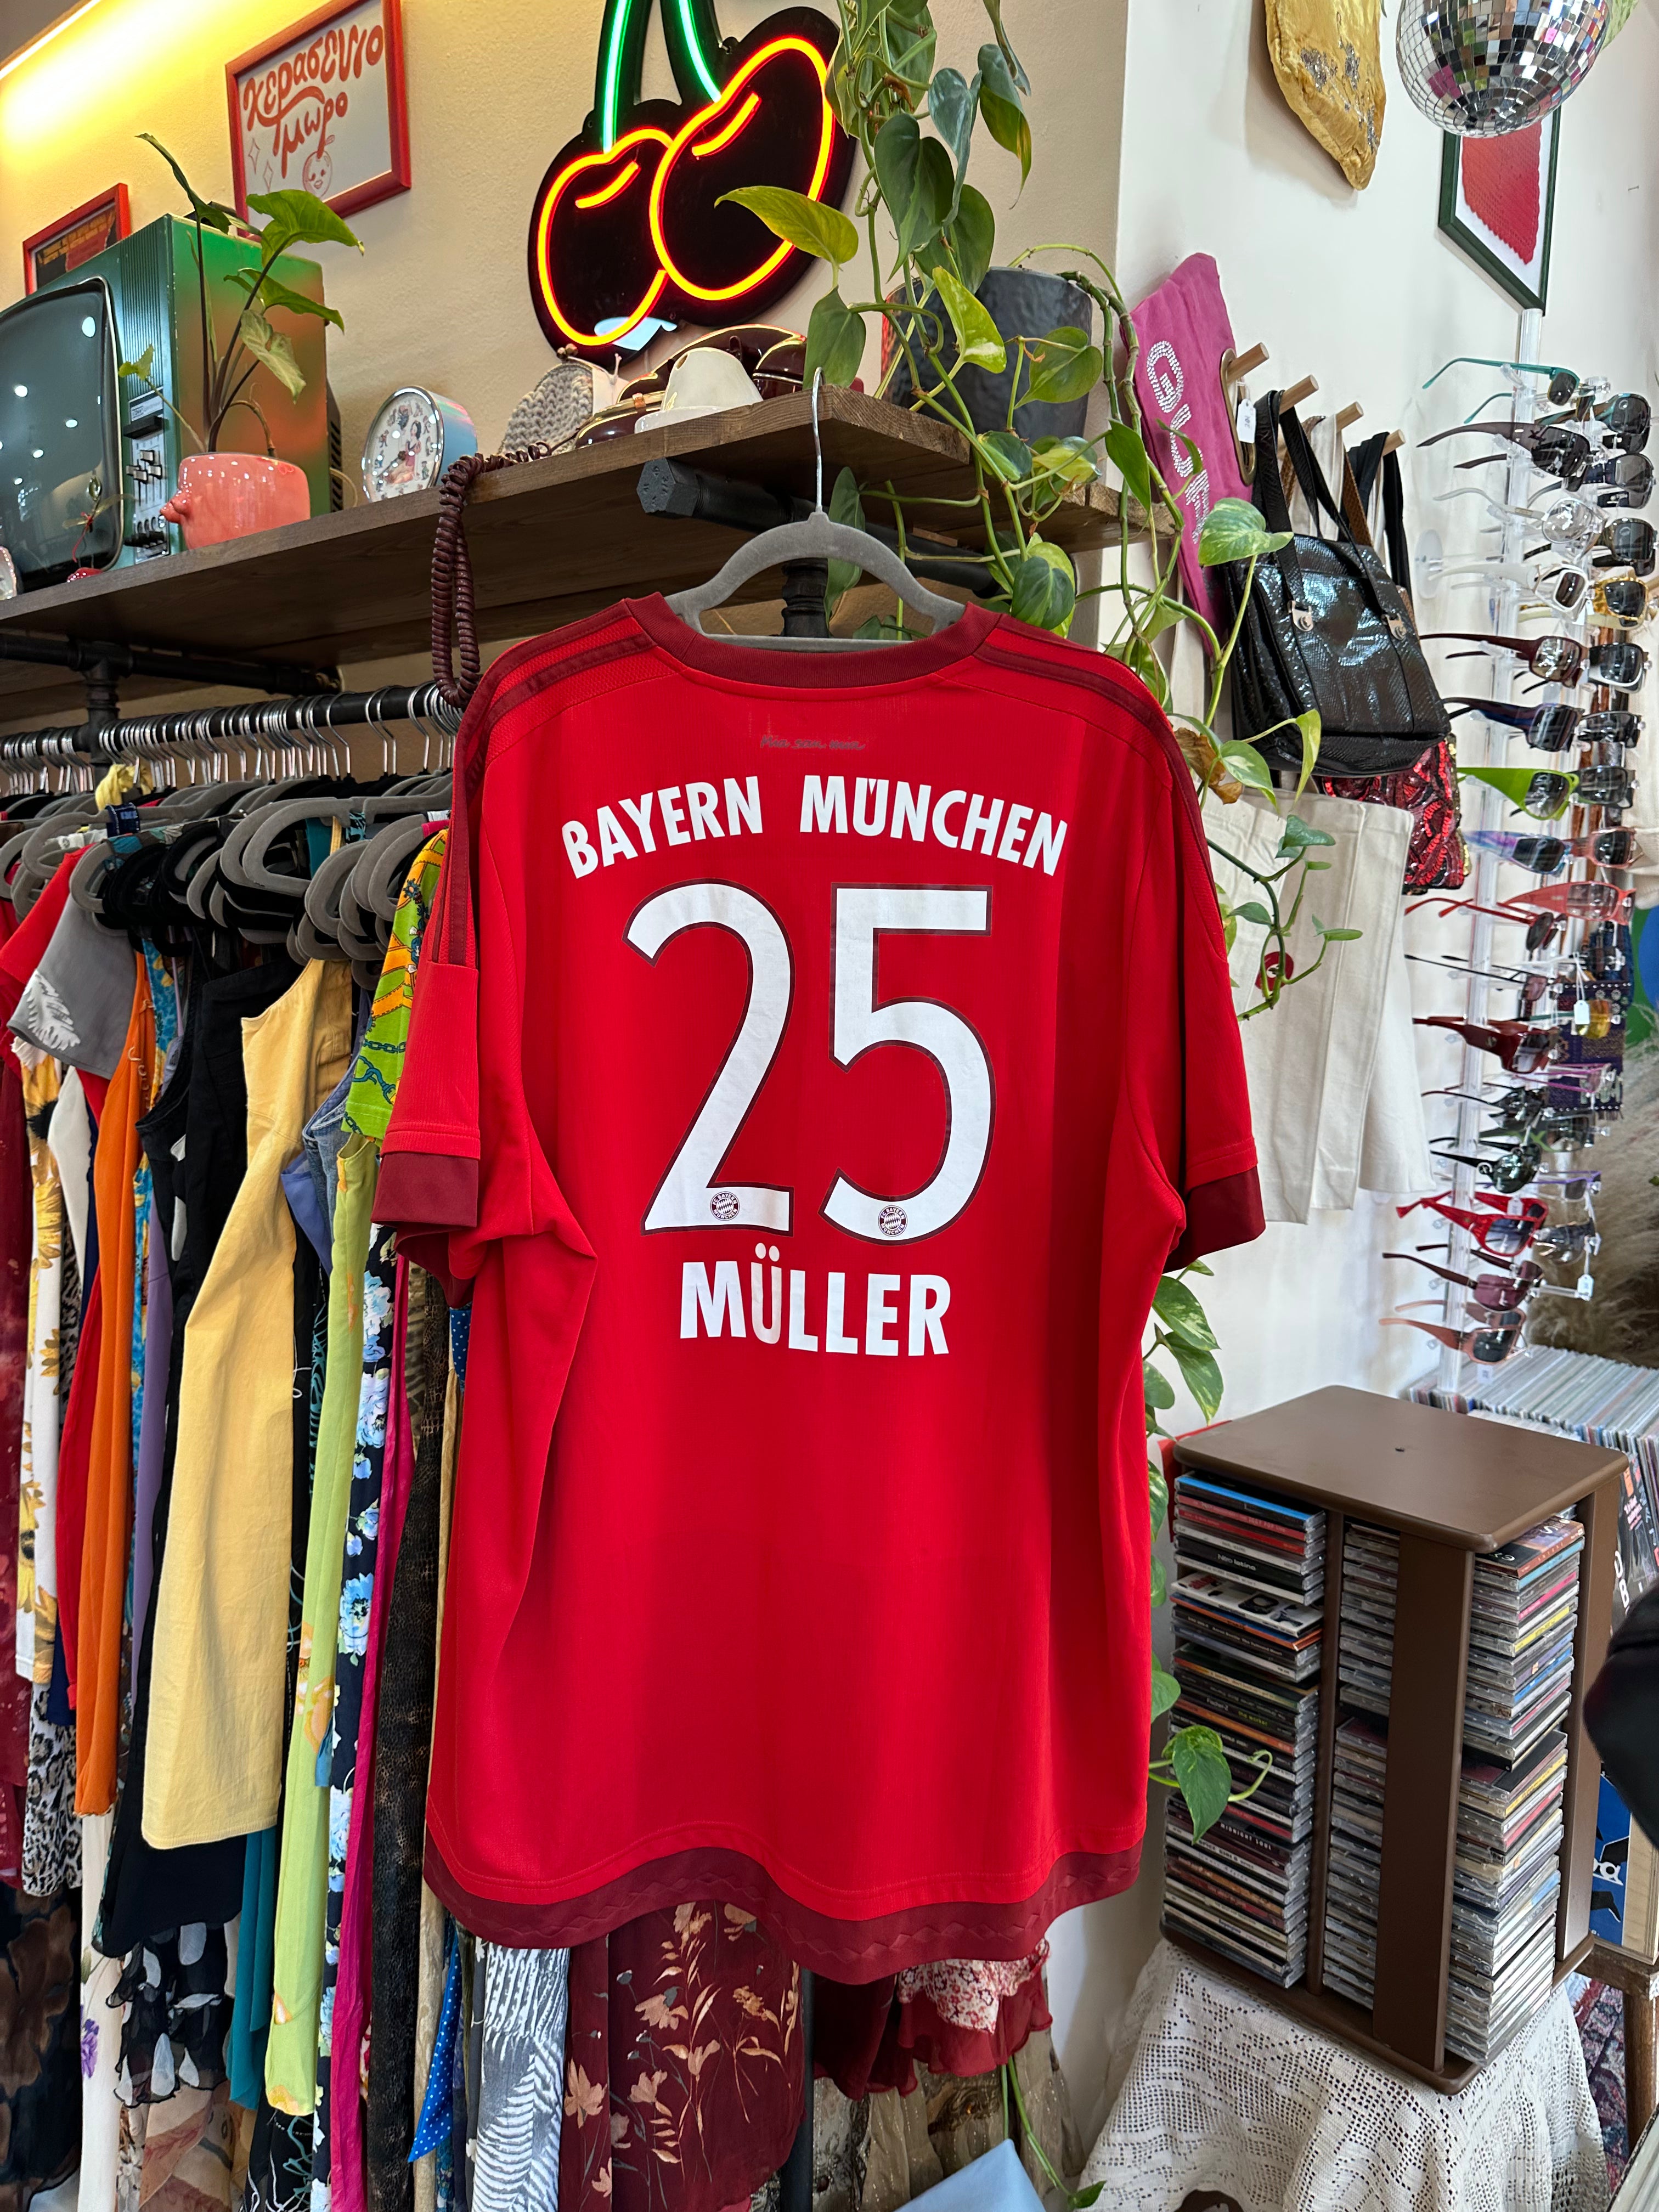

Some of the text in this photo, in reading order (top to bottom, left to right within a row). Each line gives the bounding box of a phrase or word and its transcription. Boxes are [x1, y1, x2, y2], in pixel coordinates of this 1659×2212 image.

[1147, 340, 1210, 544] GUR
[561, 775, 1068, 879] BAYERN MÜNCHEN
[622, 878, 997, 1246] 25
[717, 1193, 737, 1205] BAYERN
[885, 1207, 905, 1220] BAYERN
[680, 1242, 951, 1357] MÜLLER
[1220, 1823, 1272, 1850] MIDNIGHT SOUL
